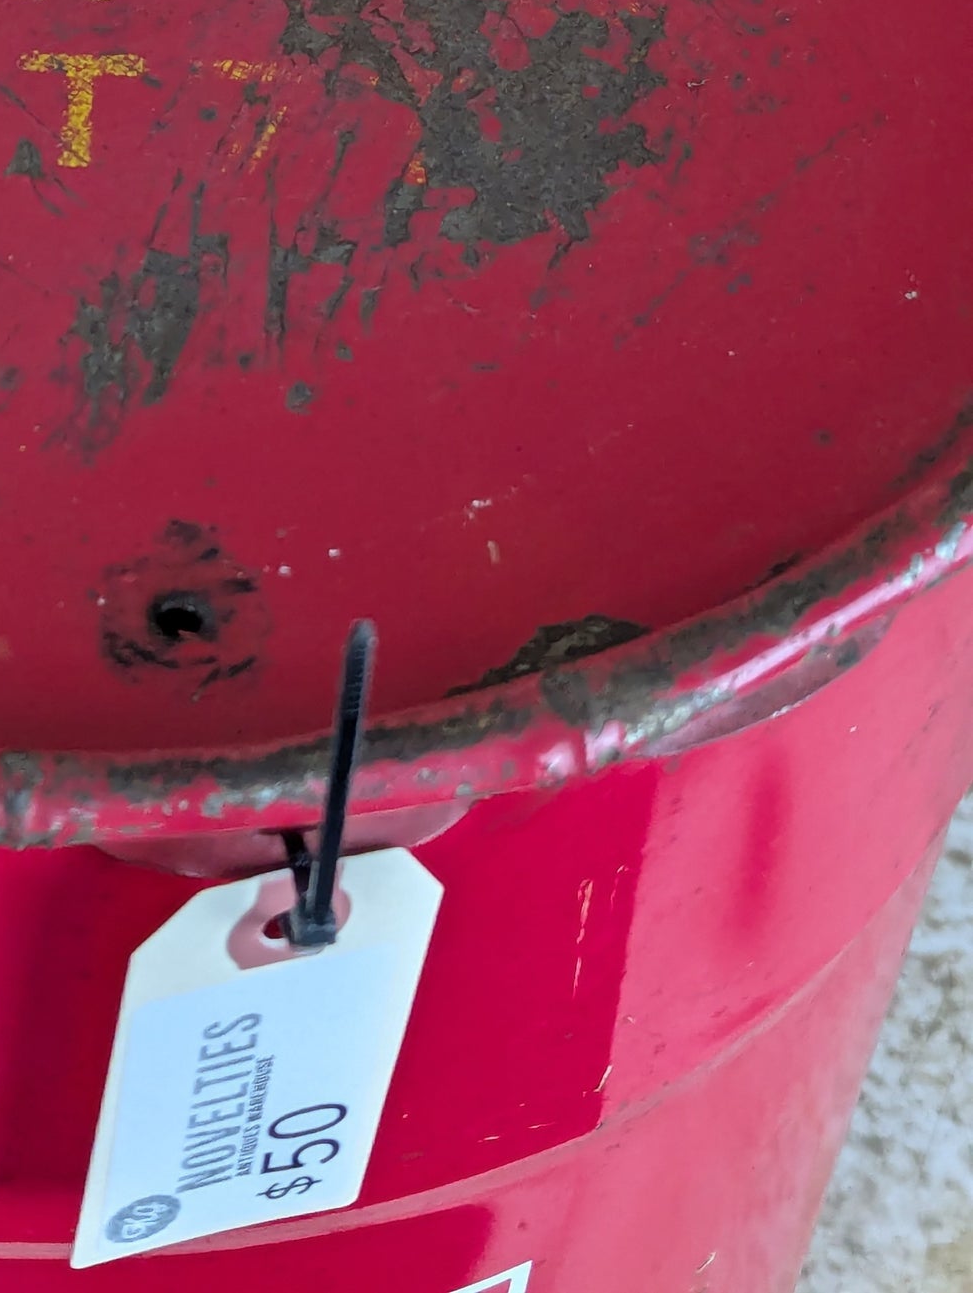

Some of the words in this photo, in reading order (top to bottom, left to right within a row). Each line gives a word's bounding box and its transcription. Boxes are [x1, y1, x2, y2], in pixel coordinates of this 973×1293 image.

[176, 1012, 263, 1194] NOVELTIES
[245, 1054, 275, 1124] WAREHOUSE
[235, 1123, 262, 1178] ANTIQUES
[255, 1102, 349, 1201] $50
